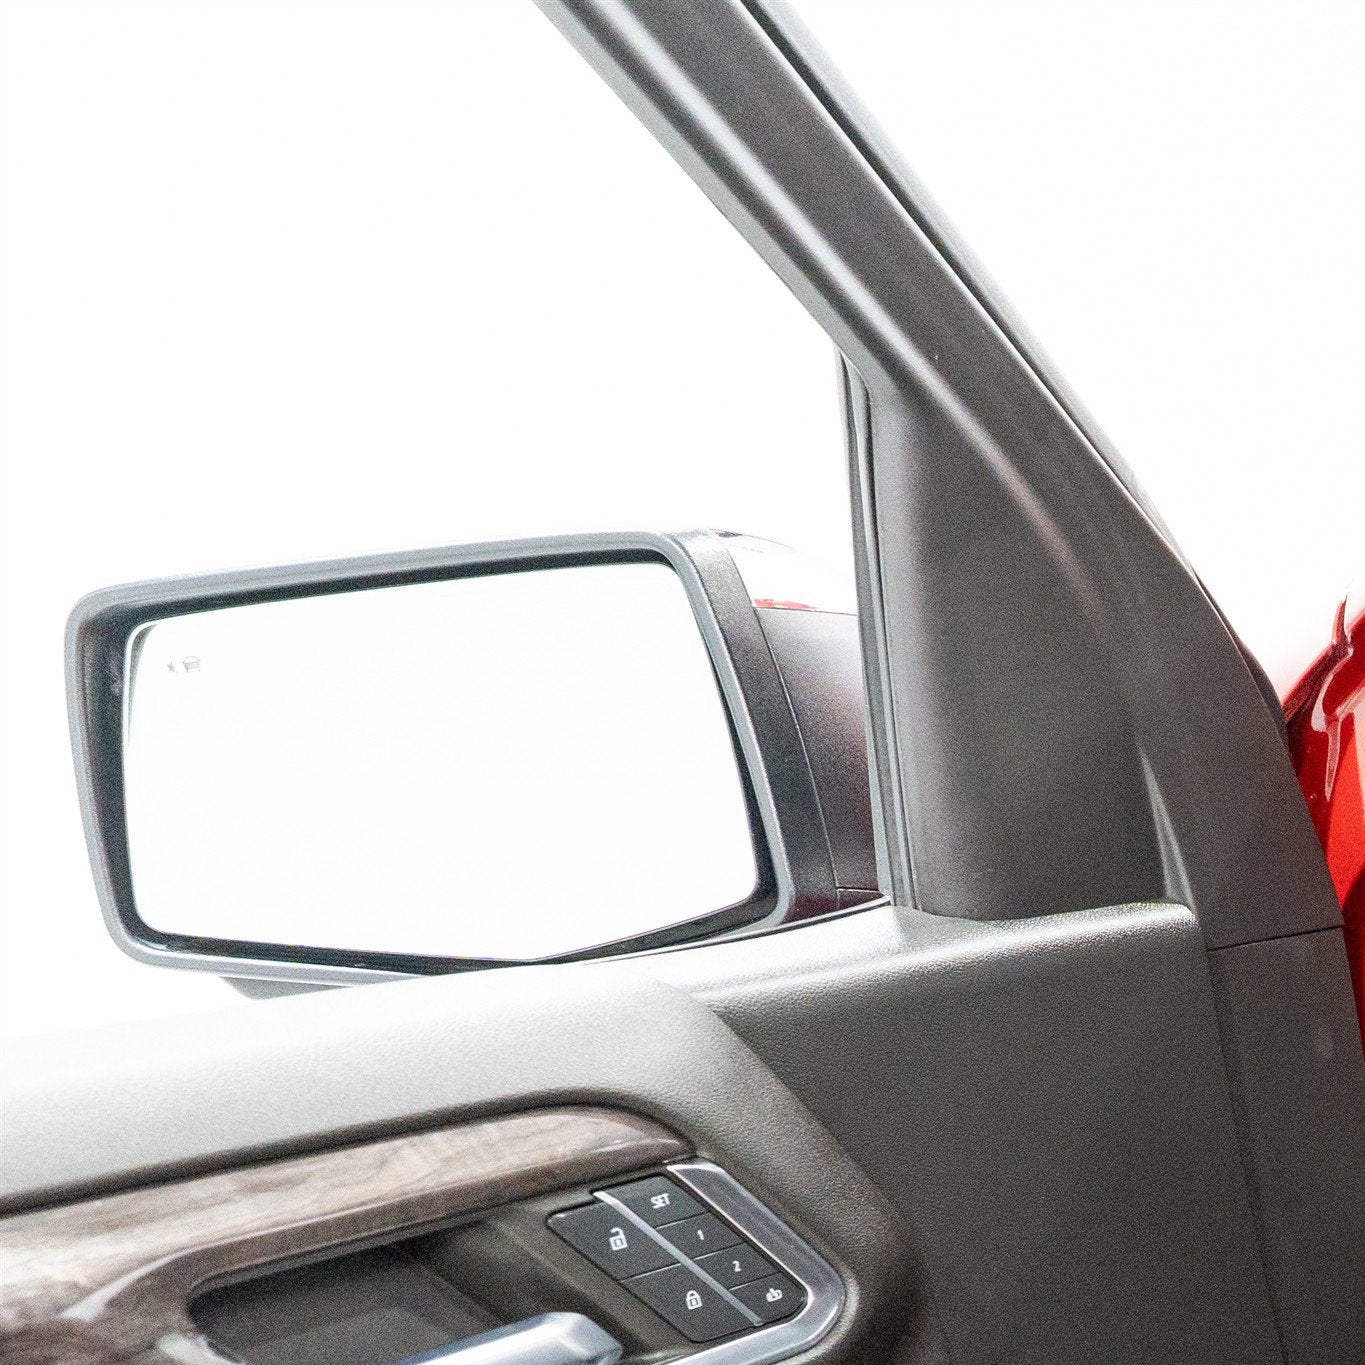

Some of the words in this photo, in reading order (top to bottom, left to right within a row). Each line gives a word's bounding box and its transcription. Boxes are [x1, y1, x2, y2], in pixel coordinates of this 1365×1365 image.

[650, 1192, 671, 1209] SET
[697, 1229, 705, 1241] 1
[731, 1260, 742, 1273] 2
